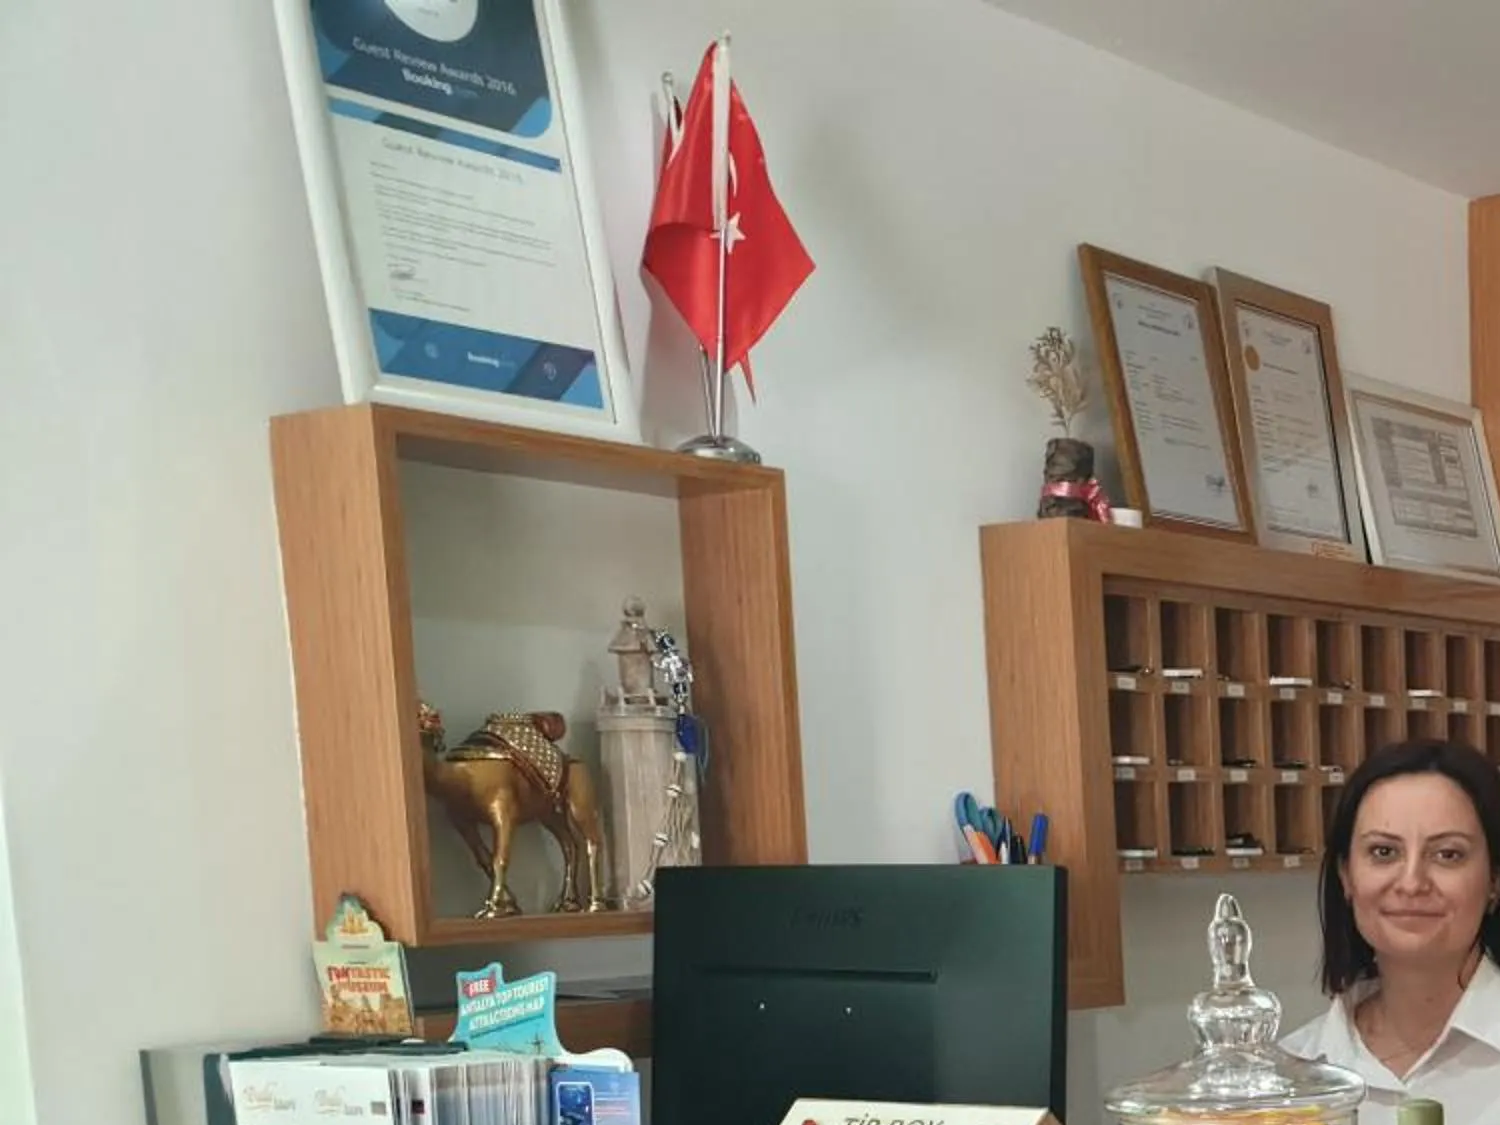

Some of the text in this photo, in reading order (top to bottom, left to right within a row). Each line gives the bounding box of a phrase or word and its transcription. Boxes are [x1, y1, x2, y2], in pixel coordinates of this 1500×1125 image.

[352, 36, 517, 96] Guest Review Awards 2016
[468, 979, 490, 998] FREE
